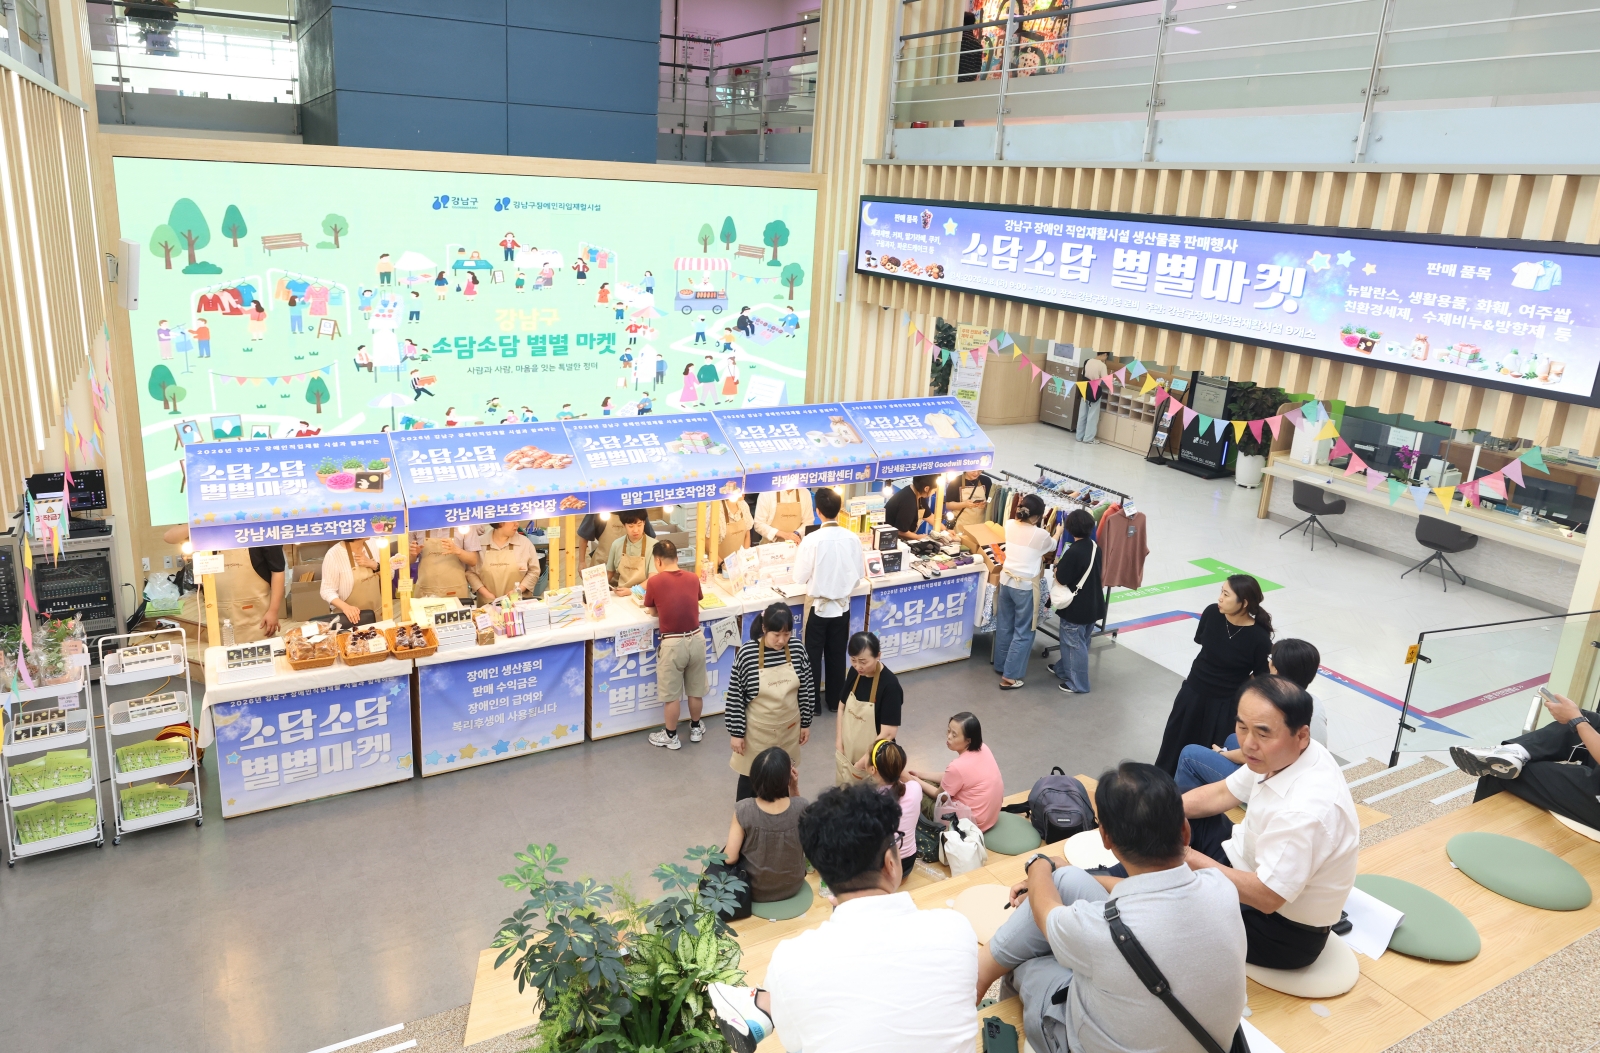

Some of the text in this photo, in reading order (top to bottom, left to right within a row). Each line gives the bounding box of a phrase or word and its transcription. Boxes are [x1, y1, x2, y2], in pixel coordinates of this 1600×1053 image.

[452, 197, 478, 206] 강남구
[895, 213, 918, 224] 판매 품목
[1004, 219, 1239, 254] 강남구 장애인 직업재활시설 생산물품 판매행사
[960, 232, 1307, 314] 소담소담 별별마켓
[1426, 261, 1492, 282] 판매 품목
[1078, 291, 1108, 306] 강남구청
[1124, 299, 1140, 311] 로비
[1285, 325, 1316, 340] 9개소
[1347, 283, 1576, 325] 뉴발란스, 생활용품, 화훼, 여주쌀,
[495, 308, 560, 332] 강남구
[1343, 299, 1414, 323] 친환경세제,
[1554, 326, 1572, 343] 등
[432, 332, 616, 359] 소담소담 별별 마켓
[467, 366, 492, 375] 사람과
[541, 363, 556, 373] 잇는
[735, 423, 799, 440] 소담소담
[863, 413, 923, 429] 소담소담
[583, 431, 661, 452] 소담소담
[738, 437, 808, 455] 별별마켓
[872, 426, 934, 443] 별별마켓
[197, 447, 232, 455] 2026년
[407, 445, 497, 466] 소담소담
[586, 446, 668, 469] 별별마켓
[199, 459, 307, 483] 소담소담
[409, 461, 503, 484] 별별마켓
[934, 458, 980, 468] Goodwill Store
[199, 477, 309, 502] 별별마켓
[771, 469, 853, 487] 라파엘직업재활센터
[620, 483, 717, 506] 밀알그린보호작업장
[444, 498, 557, 523] 강남세움보호작업장
[234, 519, 367, 544] 강남세움보호작업장
[881, 592, 967, 629] 소담소담
[880, 621, 963, 660] 별별마켓
[466, 658, 543, 683] 장애인 생산품의
[472, 676, 538, 698] 판매 수익금은
[230, 696, 262, 708] 2026년
[467, 690, 543, 715] 장애인의 급여와
[240, 696, 392, 751] 소담소담
[452, 702, 558, 732] 복리후생에 사용됩니다
[241, 732, 392, 792] 별별마켓
